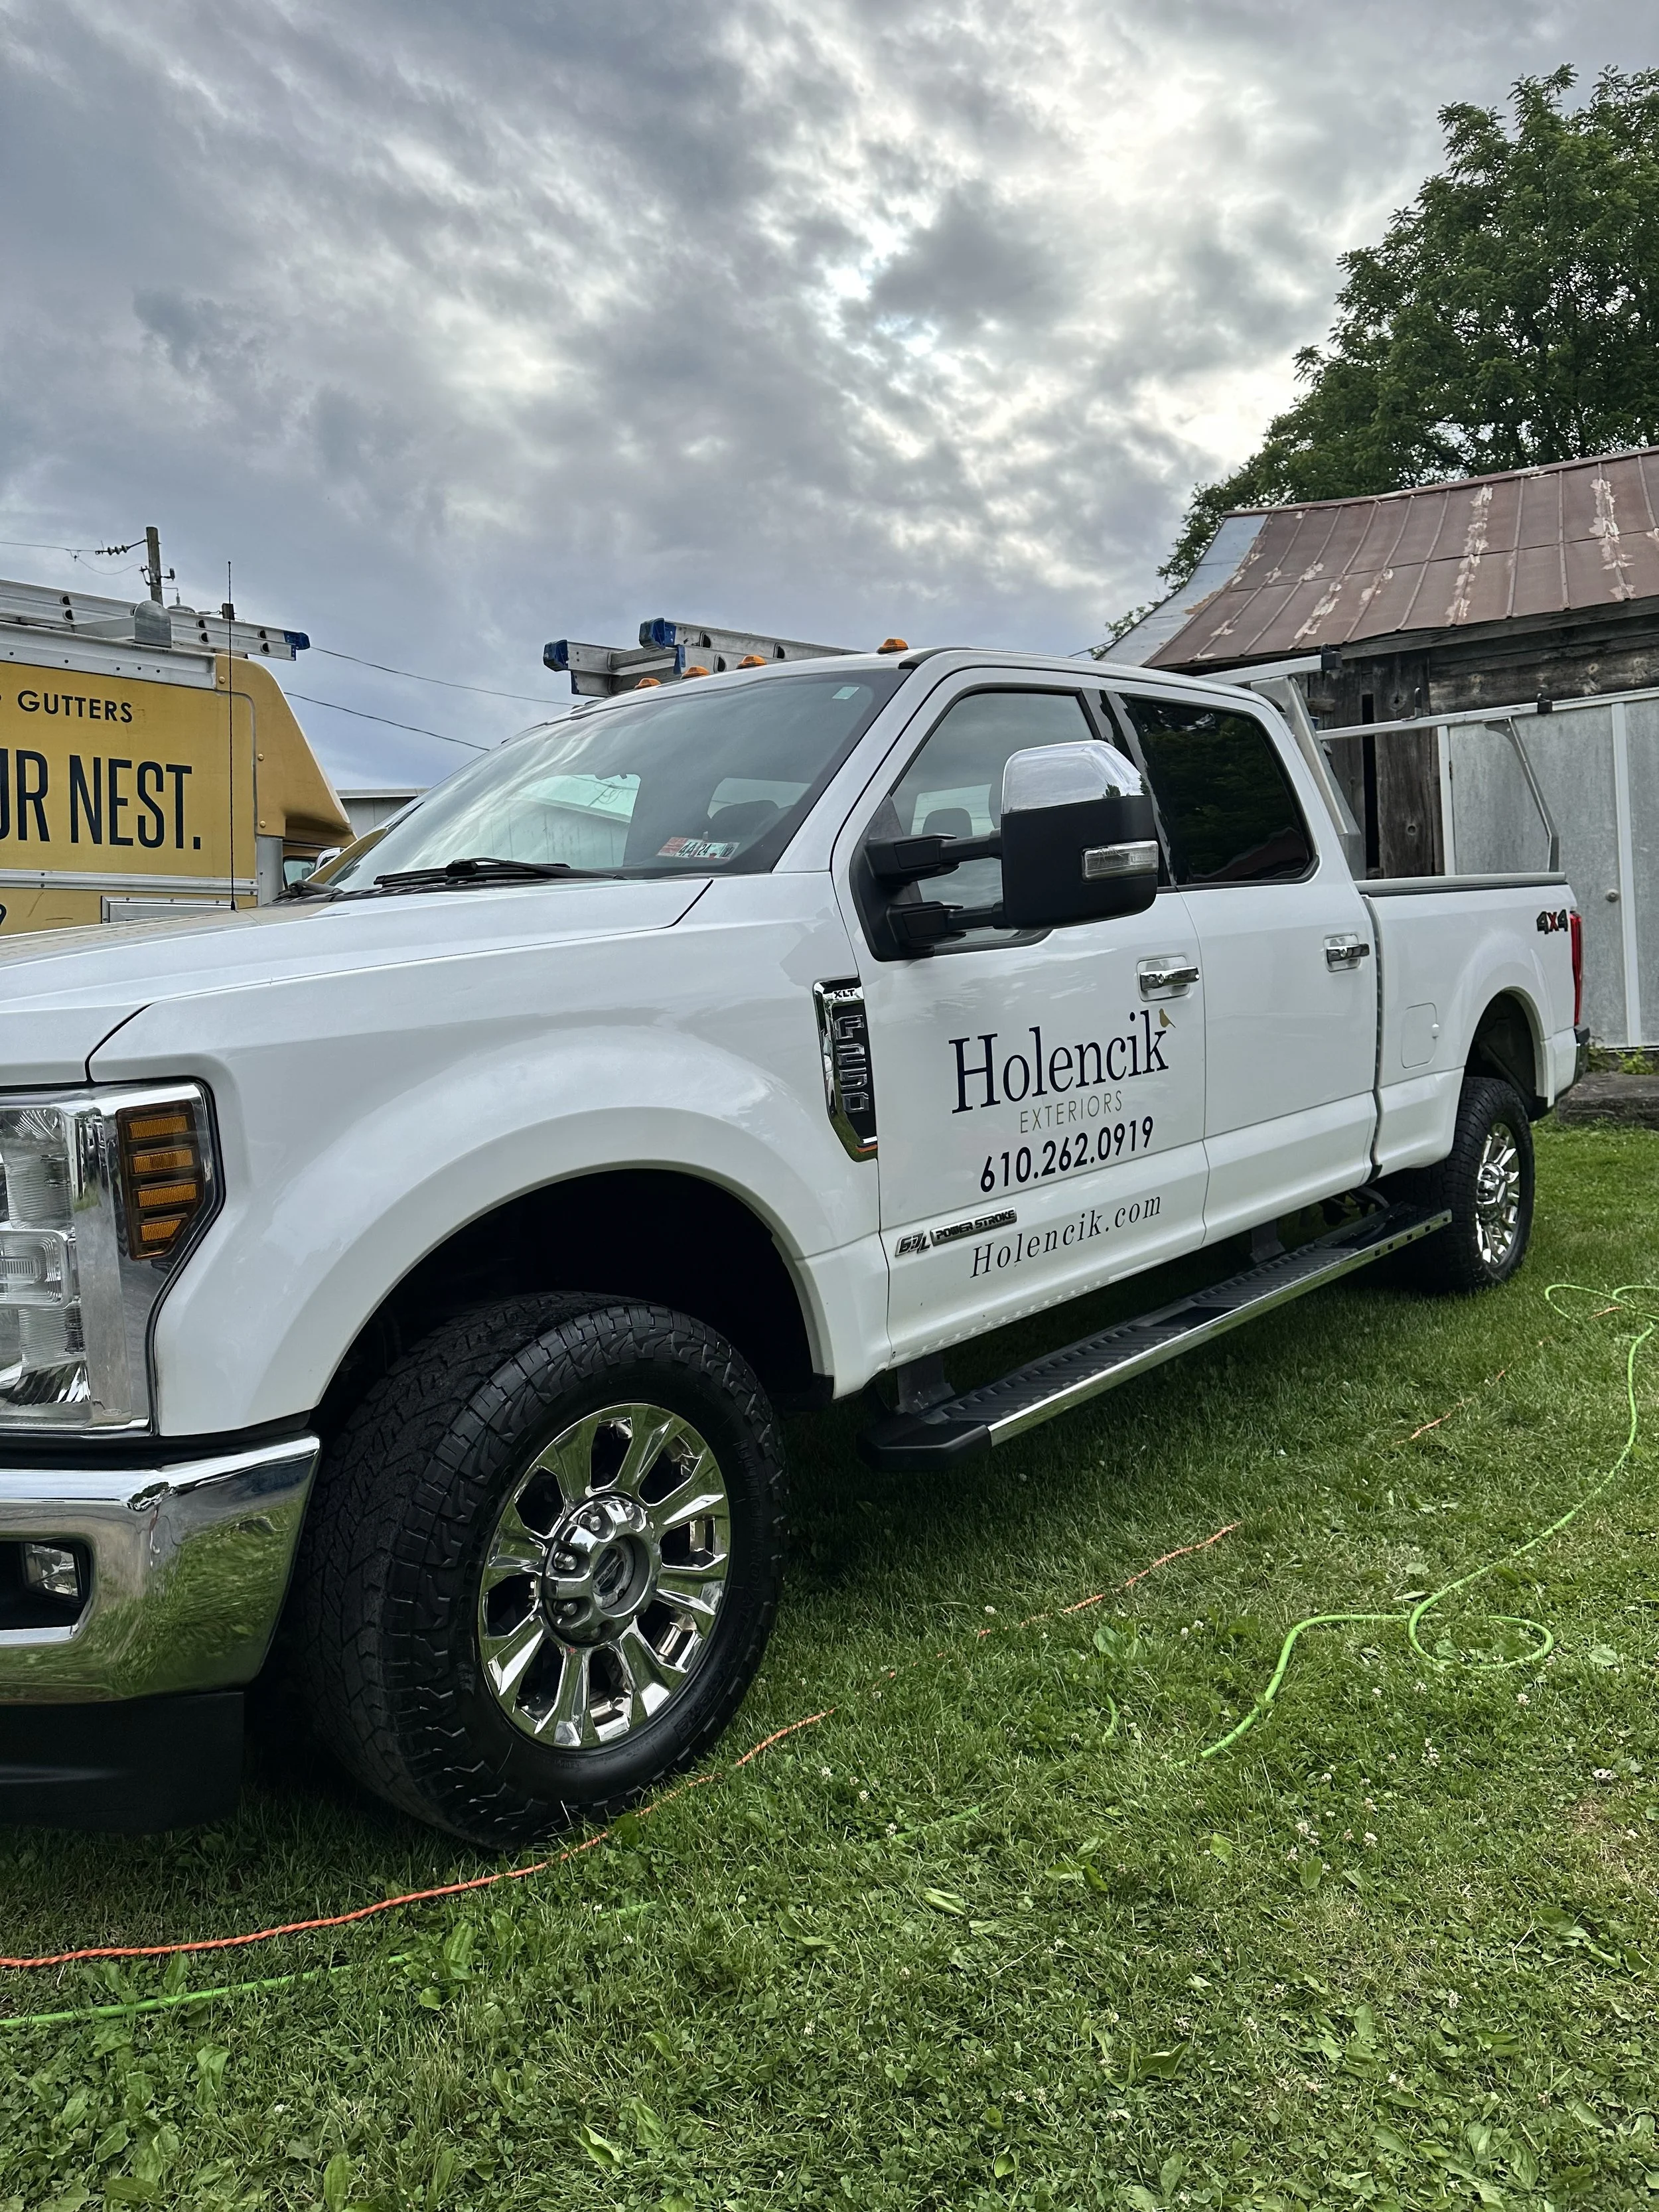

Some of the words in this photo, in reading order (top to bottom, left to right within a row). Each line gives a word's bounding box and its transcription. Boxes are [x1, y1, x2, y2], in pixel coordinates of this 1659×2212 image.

[17, 690, 133, 723] GUTTERS
[69, 754, 201, 849] NEST.
[833, 989, 855, 999] XLT
[948, 1009, 1169, 1114] Holencik
[1019, 1090, 1123, 1134] EXTERIORS
[980, 1116, 1154, 1193] 610.262.0919
[935, 1222, 973, 1240] POWER
[974, 1209, 1015, 1228] STROKE
[970, 1197, 1161, 1278] Holencik.com
